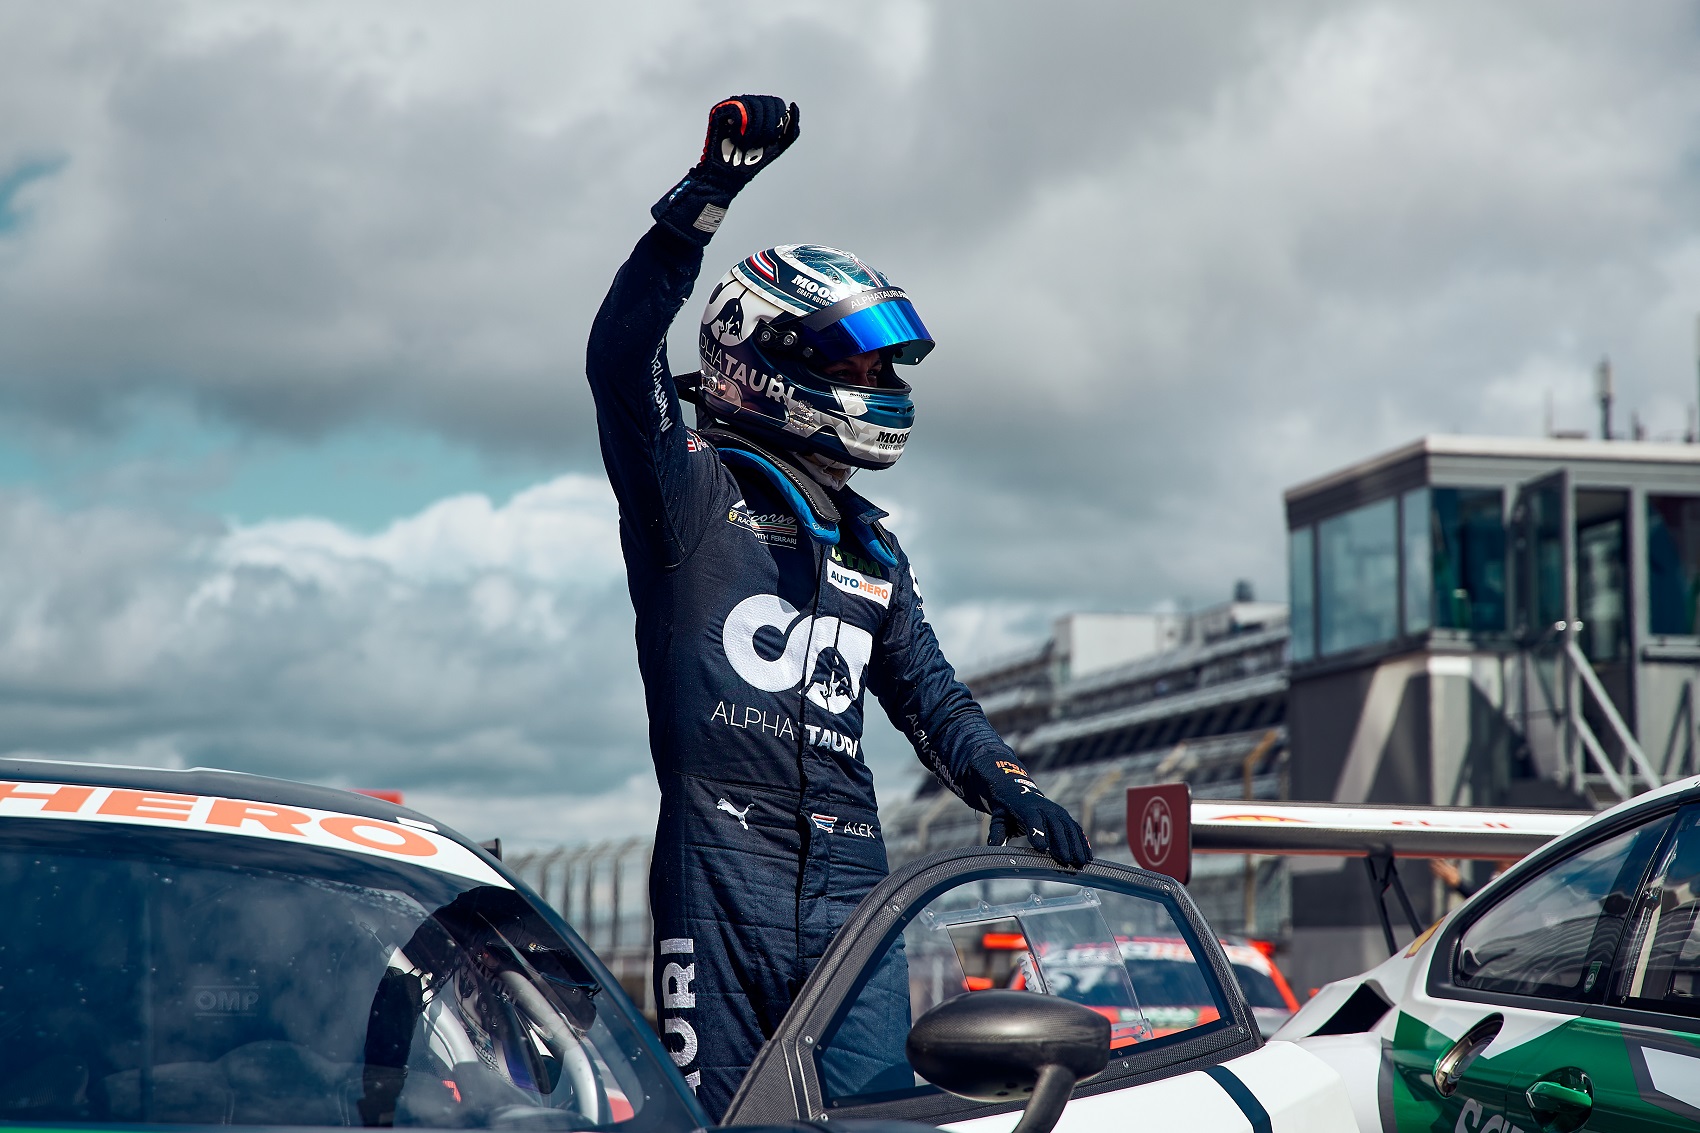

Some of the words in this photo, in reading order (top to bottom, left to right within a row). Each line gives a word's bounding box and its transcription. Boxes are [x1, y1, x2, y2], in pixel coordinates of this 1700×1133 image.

[770, 534, 797, 545] FERRARI
[830, 570, 889, 600] AUTOHERO
[0, 783, 438, 857] HERO
[844, 822, 876, 839] ALEK
[195, 990, 259, 1011] OMP
